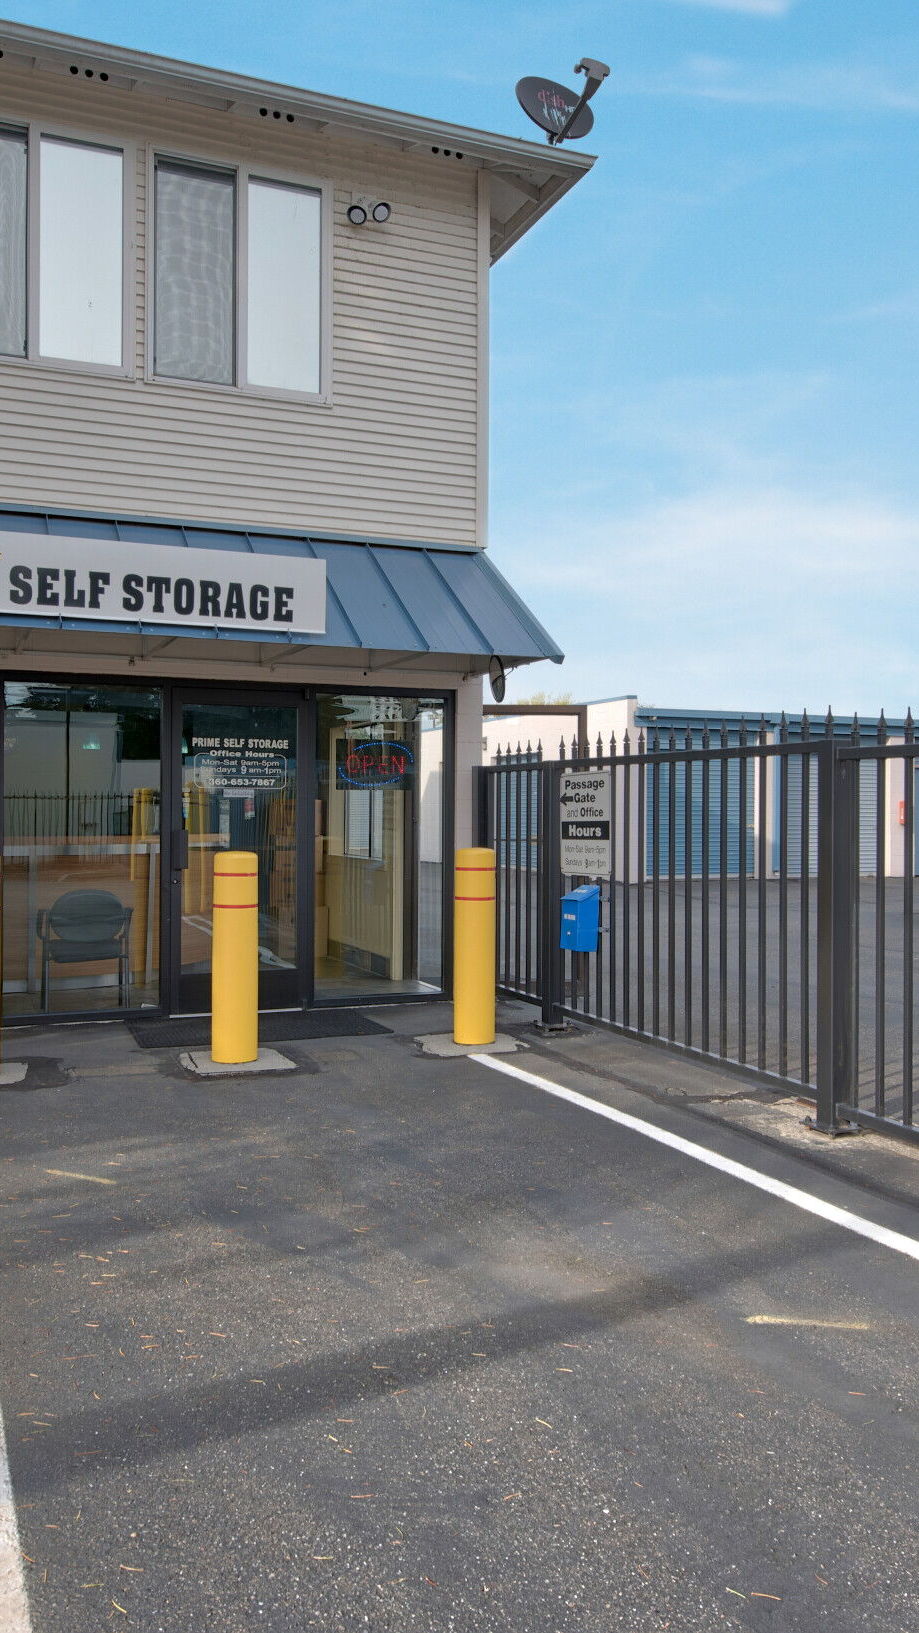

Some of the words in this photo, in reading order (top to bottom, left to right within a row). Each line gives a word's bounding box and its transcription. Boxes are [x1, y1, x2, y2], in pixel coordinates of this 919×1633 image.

[9, 565, 111, 609] SELF
[122, 573, 294, 622] STORAGE
[192, 737, 221, 748] PRIME
[223, 738, 245, 748] SELF
[247, 739, 289, 750] STORAGE
[209, 749, 242, 757] Office
[245, 750, 275, 758] Hours
[240, 759, 280, 768] 9am-5pm
[345, 754, 406, 775] OPEN
[565, 779, 605, 791] Passage
[574, 792, 596, 803] Gate
[566, 809, 579, 818] and
[580, 807, 604, 818] Office
[568, 824, 602, 838] Hours
